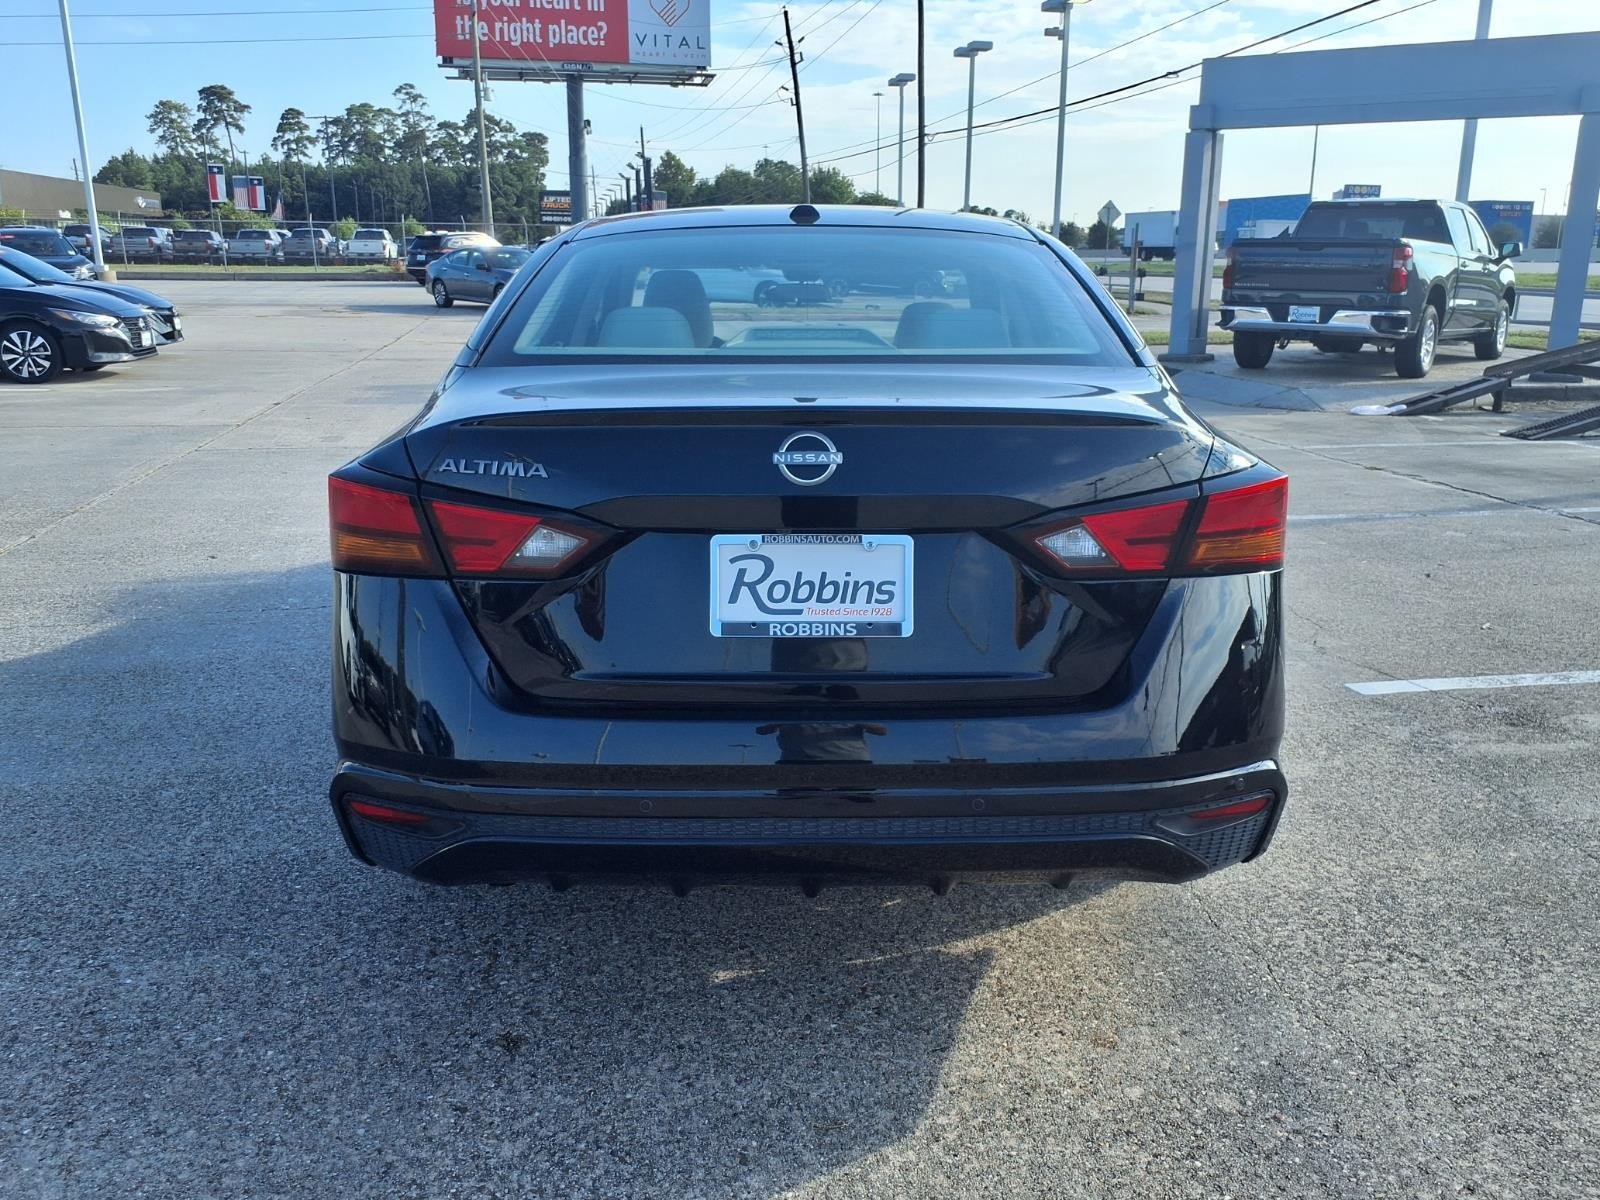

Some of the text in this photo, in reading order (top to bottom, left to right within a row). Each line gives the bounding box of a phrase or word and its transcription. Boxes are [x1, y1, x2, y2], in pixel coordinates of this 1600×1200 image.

[455, 15, 608, 48] the right place?
[635, 32, 706, 50] VITAL
[1348, 185, 1380, 195] ROOMS
[774, 453, 841, 463] NISSAN
[439, 458, 549, 479] ALTIMA
[764, 534, 860, 544] ROBBINSAUTO.COM
[727, 553, 897, 616] Robbins
[806, 607, 892, 616] Trusted Since 1928
[769, 623, 857, 636] ROBBINS
